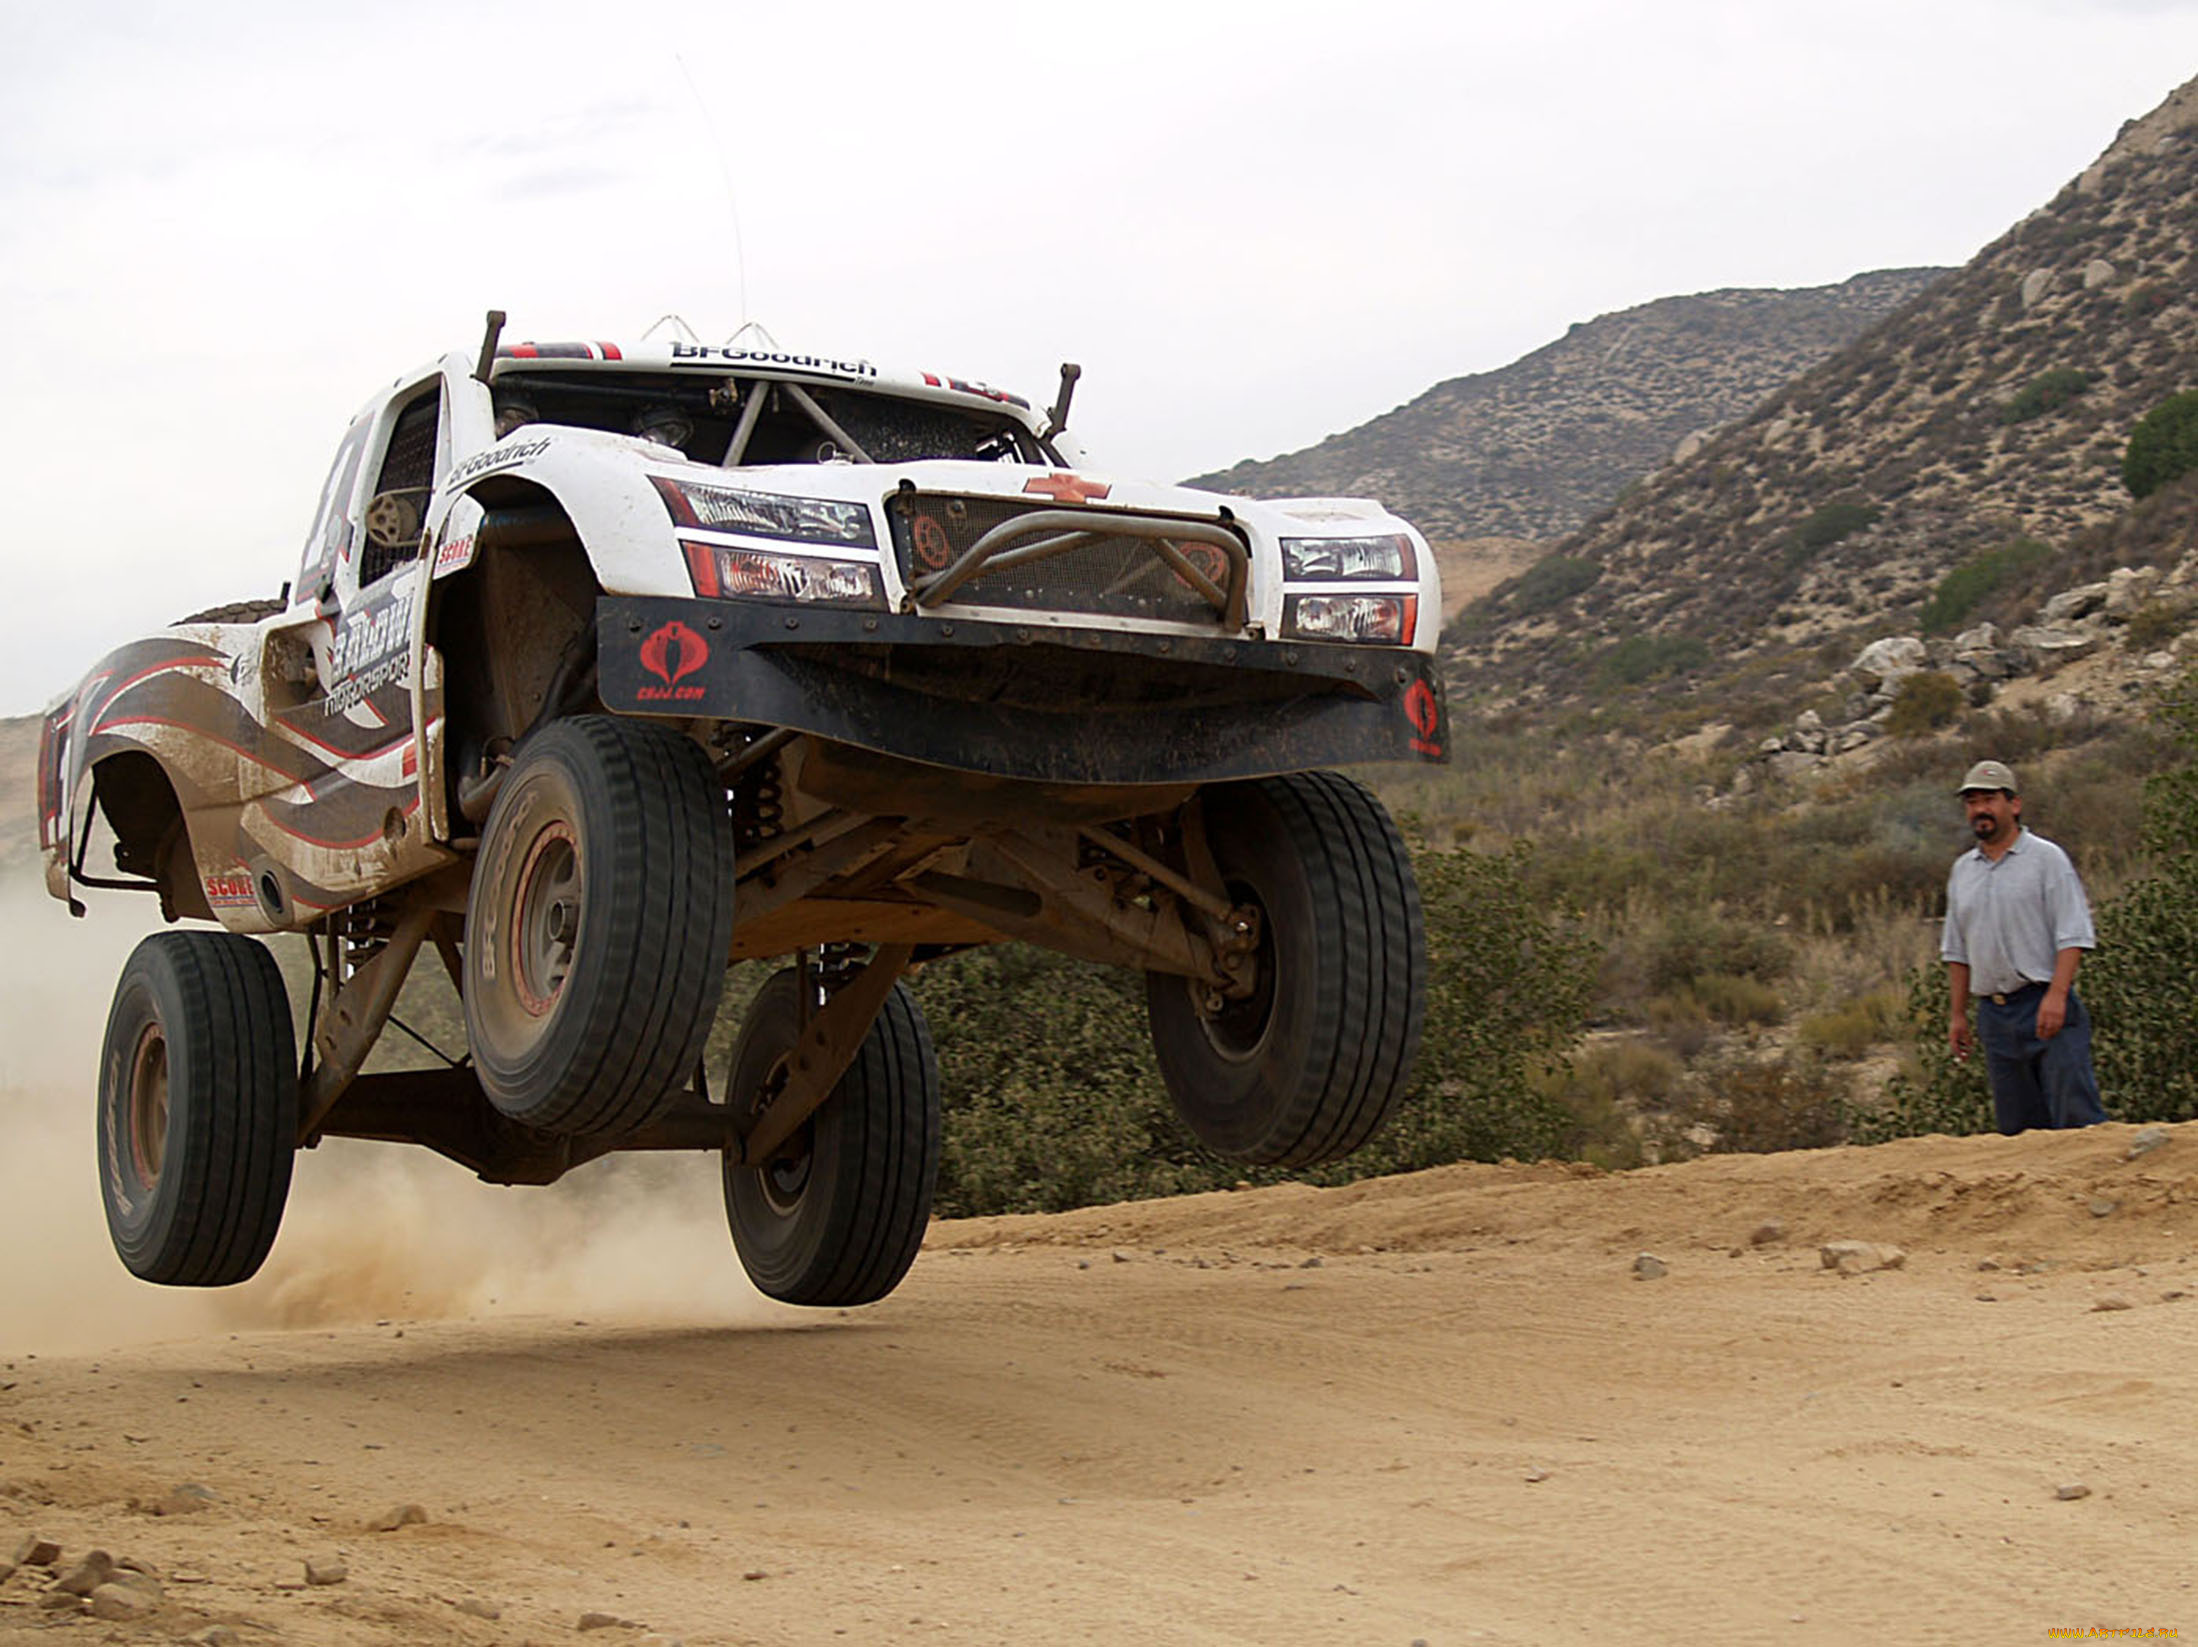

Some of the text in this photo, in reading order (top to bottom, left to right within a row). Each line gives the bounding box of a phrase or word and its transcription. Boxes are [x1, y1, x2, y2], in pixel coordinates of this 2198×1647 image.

[671, 341, 878, 378] BFGoodrich
[438, 534, 474, 566] SCORE
[324, 652, 410, 718] MOTORSPOR
[206, 876, 256, 897] SCORE
